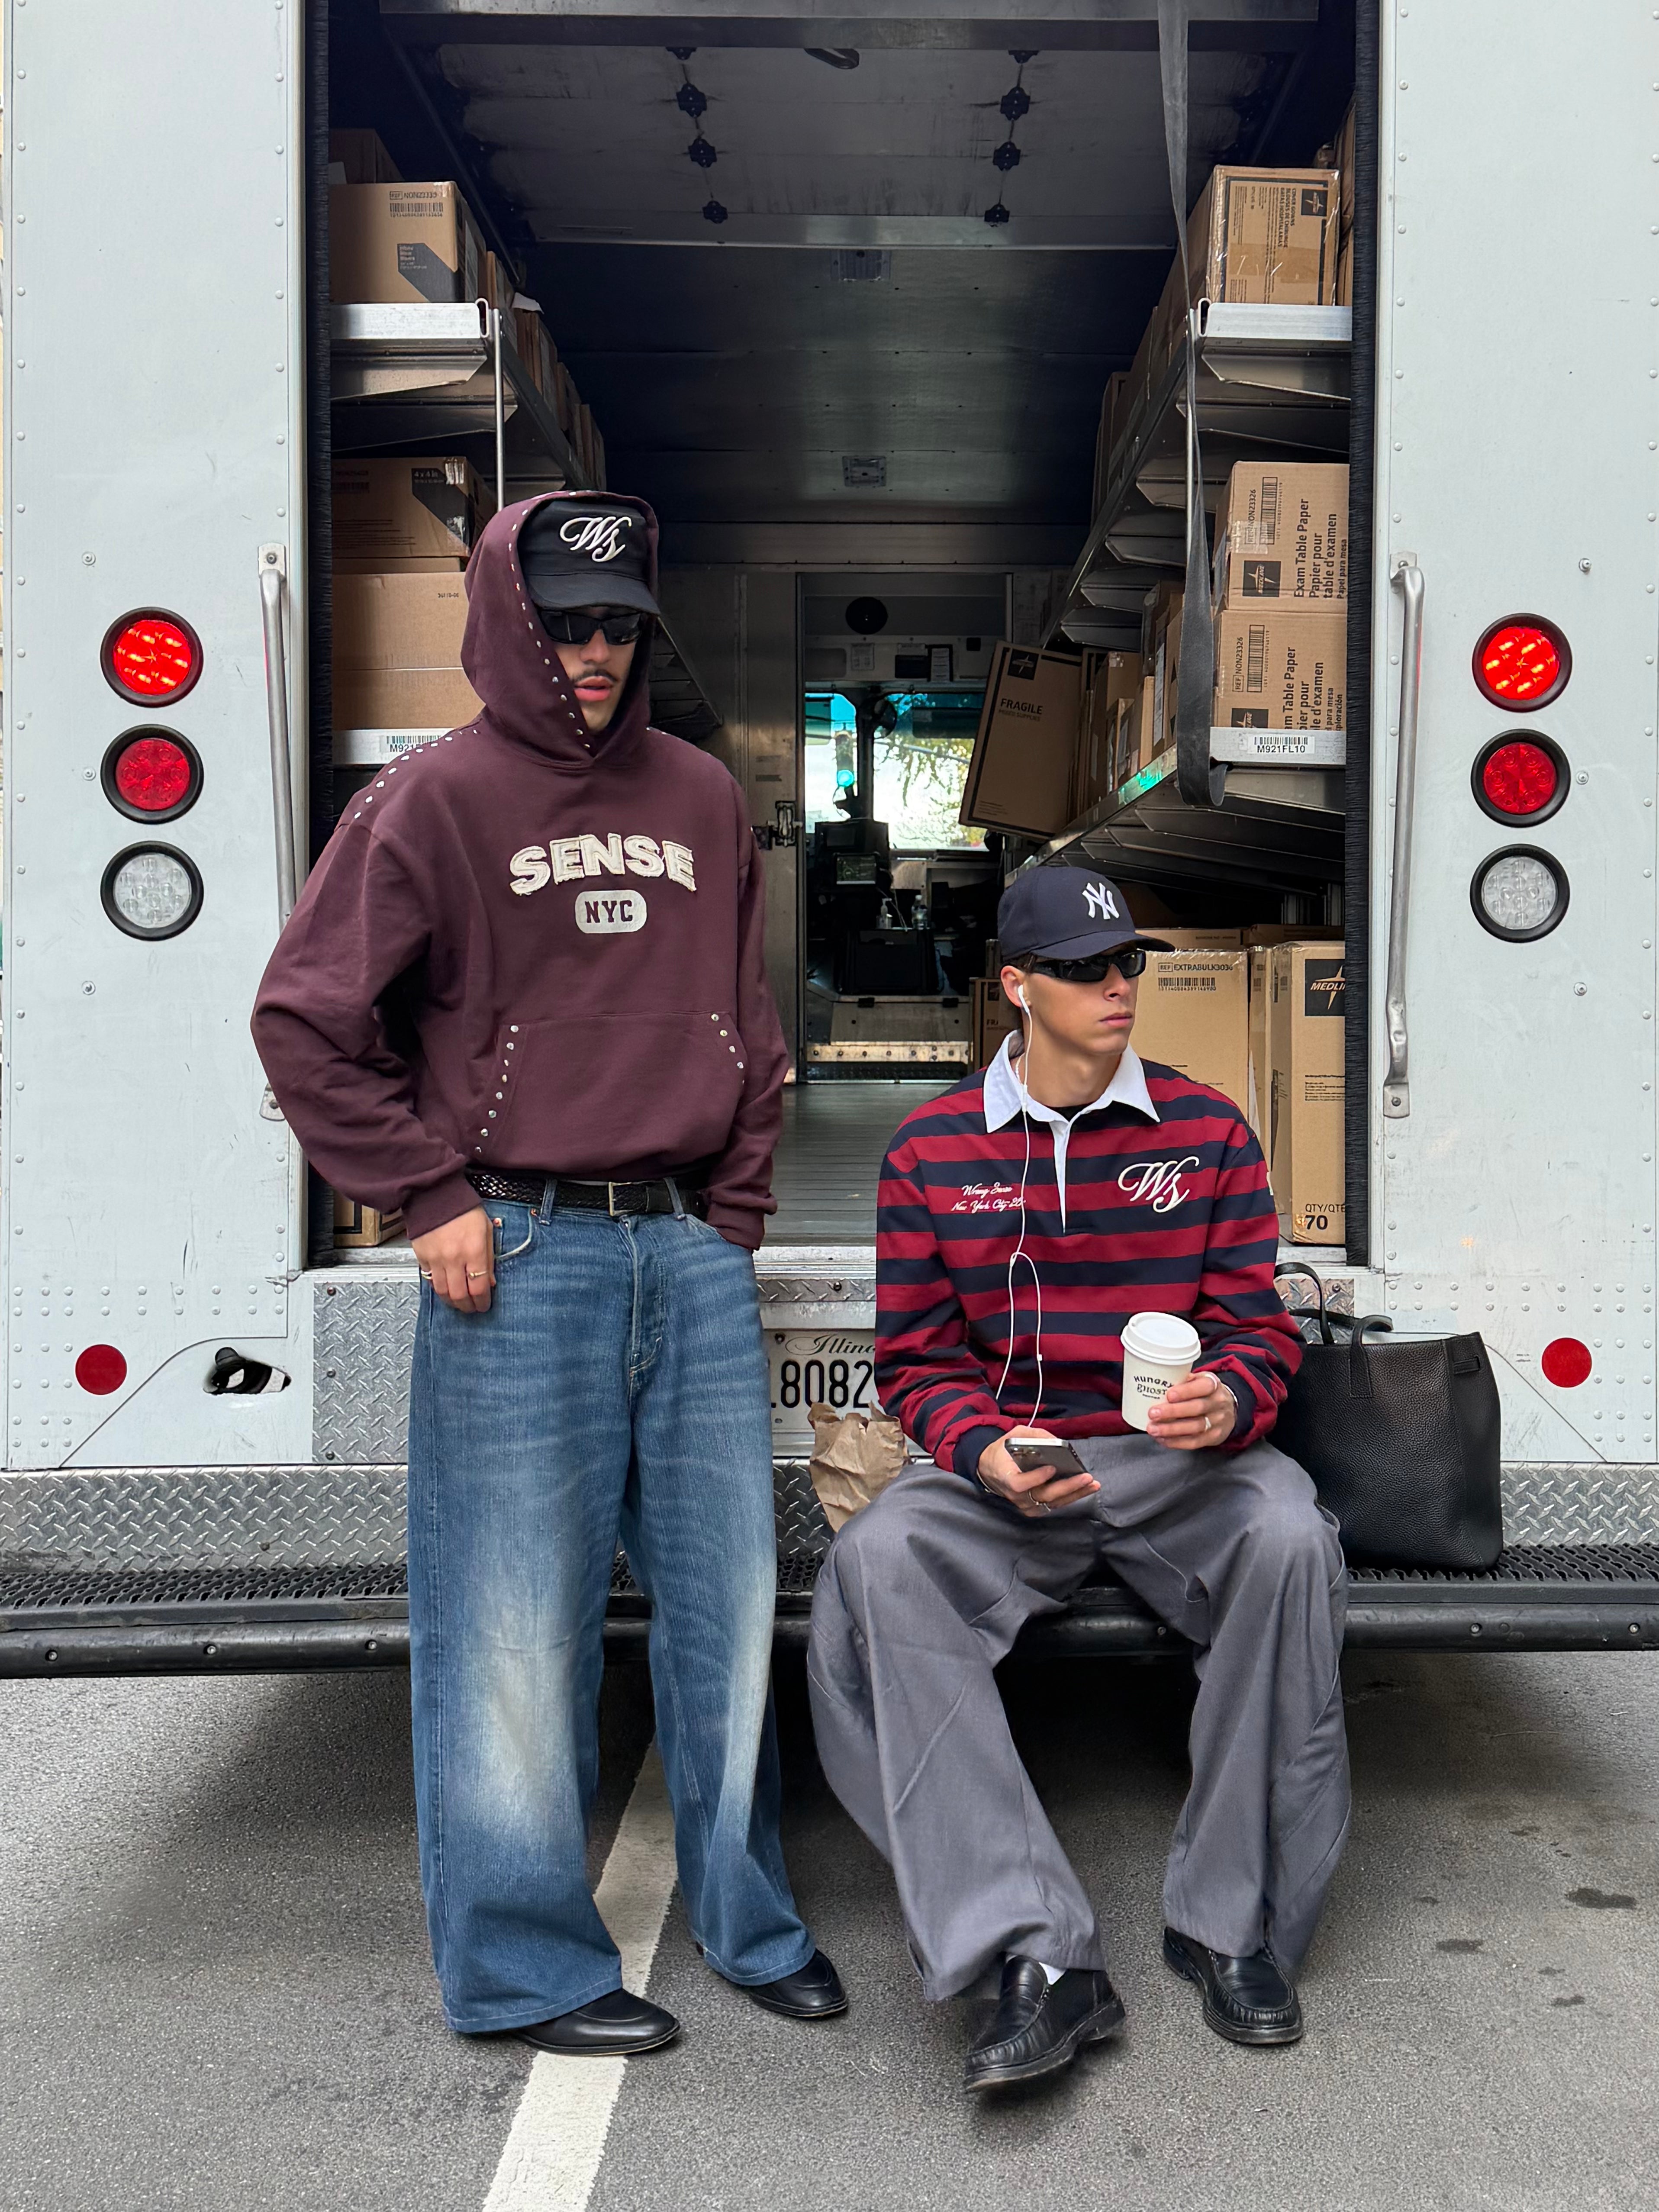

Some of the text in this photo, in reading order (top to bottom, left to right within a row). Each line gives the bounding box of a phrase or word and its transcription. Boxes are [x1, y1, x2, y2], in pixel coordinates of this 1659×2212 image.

[1248, 489, 1256, 526] NON23326
[1294, 498, 1311, 598] Exam Table Paper
[1309, 533, 1325, 598] Papier pour
[1323, 514, 1337, 599] table d'examen
[1337, 579, 1345, 599] Papel
[1235, 637, 1243, 674] NON23326
[1000, 698, 1043, 714] FRAGILE
[1282, 647, 1298, 729] am Table Paper
[1300, 681, 1311, 708] pour
[1311, 662, 1324, 716] d'examen
[1257, 745, 1305, 753] M921FL10
[509, 832, 697, 896] SENSE
[585, 900, 633, 923] NYC
[1082, 882, 1120, 919] NY
[1310, 982, 1346, 991] MEDLI
[950, 1200, 968, 1211] New
[970, 1200, 990, 1213] York
[1305, 1215, 1328, 1230] 70
[771, 1359, 873, 1408] 8082
